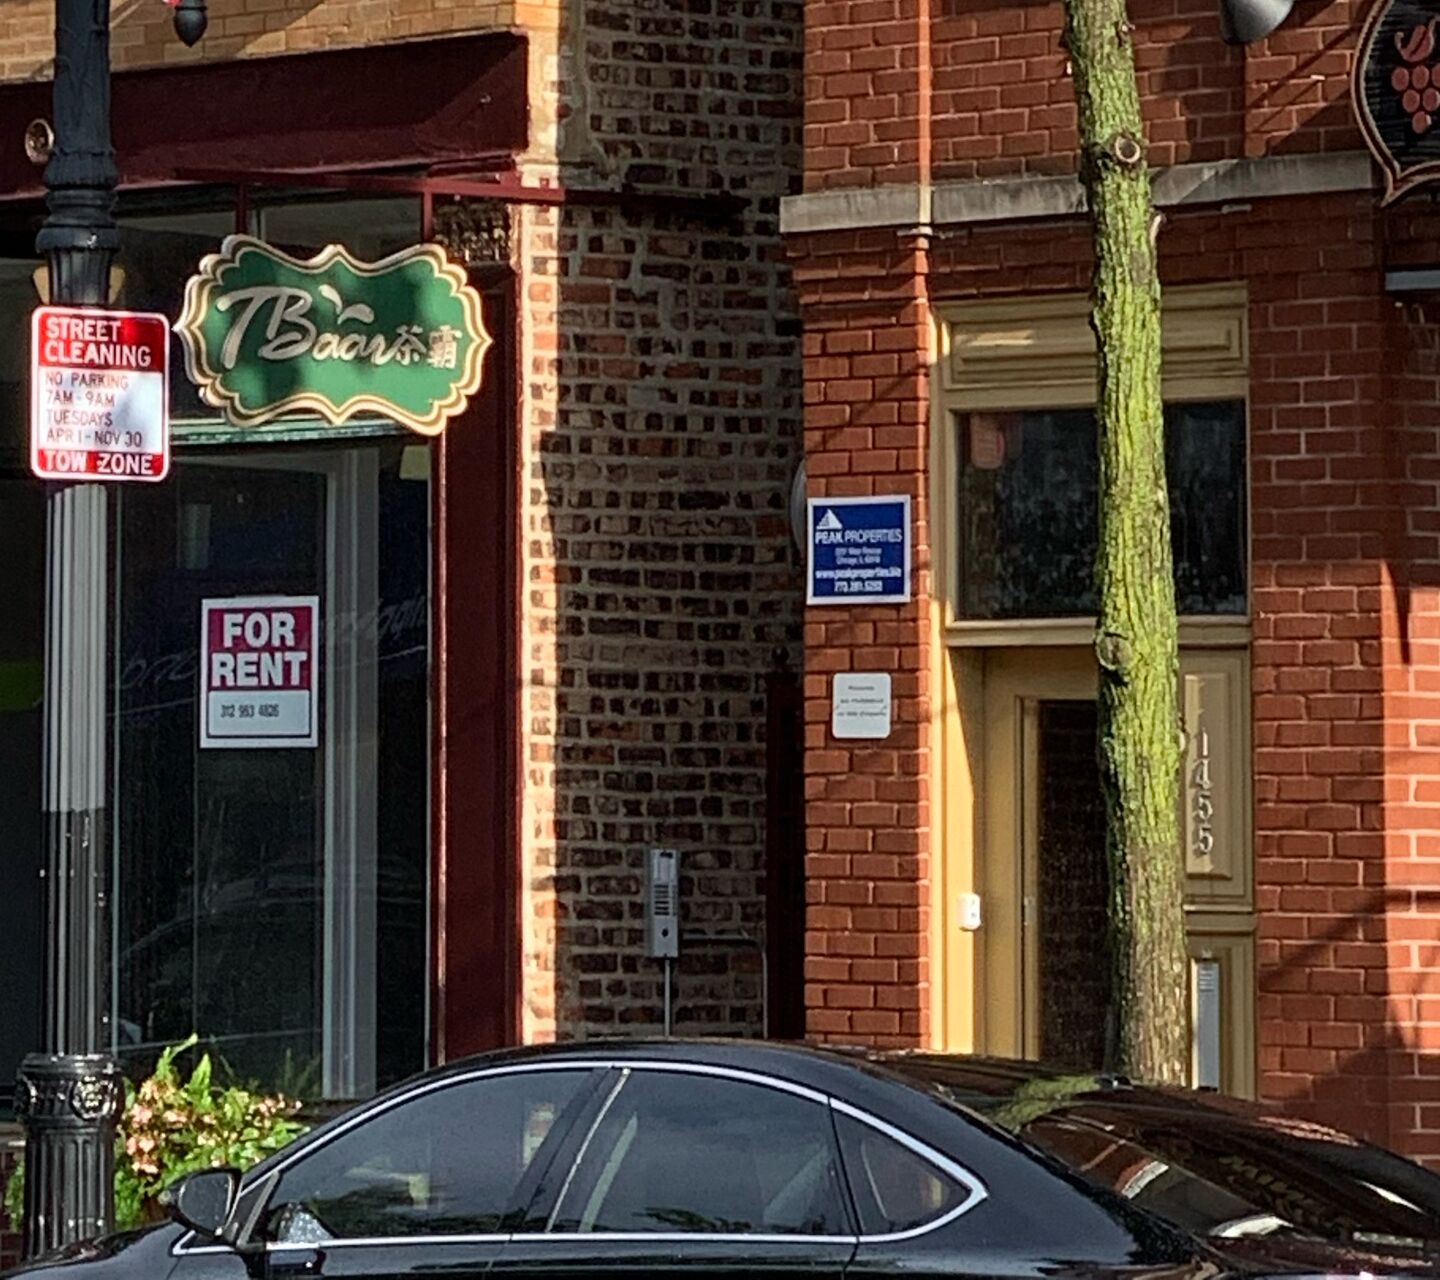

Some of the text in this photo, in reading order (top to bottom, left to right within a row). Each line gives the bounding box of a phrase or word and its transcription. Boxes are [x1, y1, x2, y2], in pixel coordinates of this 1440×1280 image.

[45, 316, 122, 343] STREET
[44, 341, 152, 368] CLEANING
[46, 372, 129, 390] NO PARKING
[46, 408, 114, 426] TUESDAYS
[47, 427, 72, 444] APR
[124, 431, 143, 447] 30
[45, 451, 154, 475] TOW ZONE
[815, 528, 903, 544] PEAK PROPERTIES
[223, 612, 296, 648] FOR
[211, 651, 308, 687] RENT
